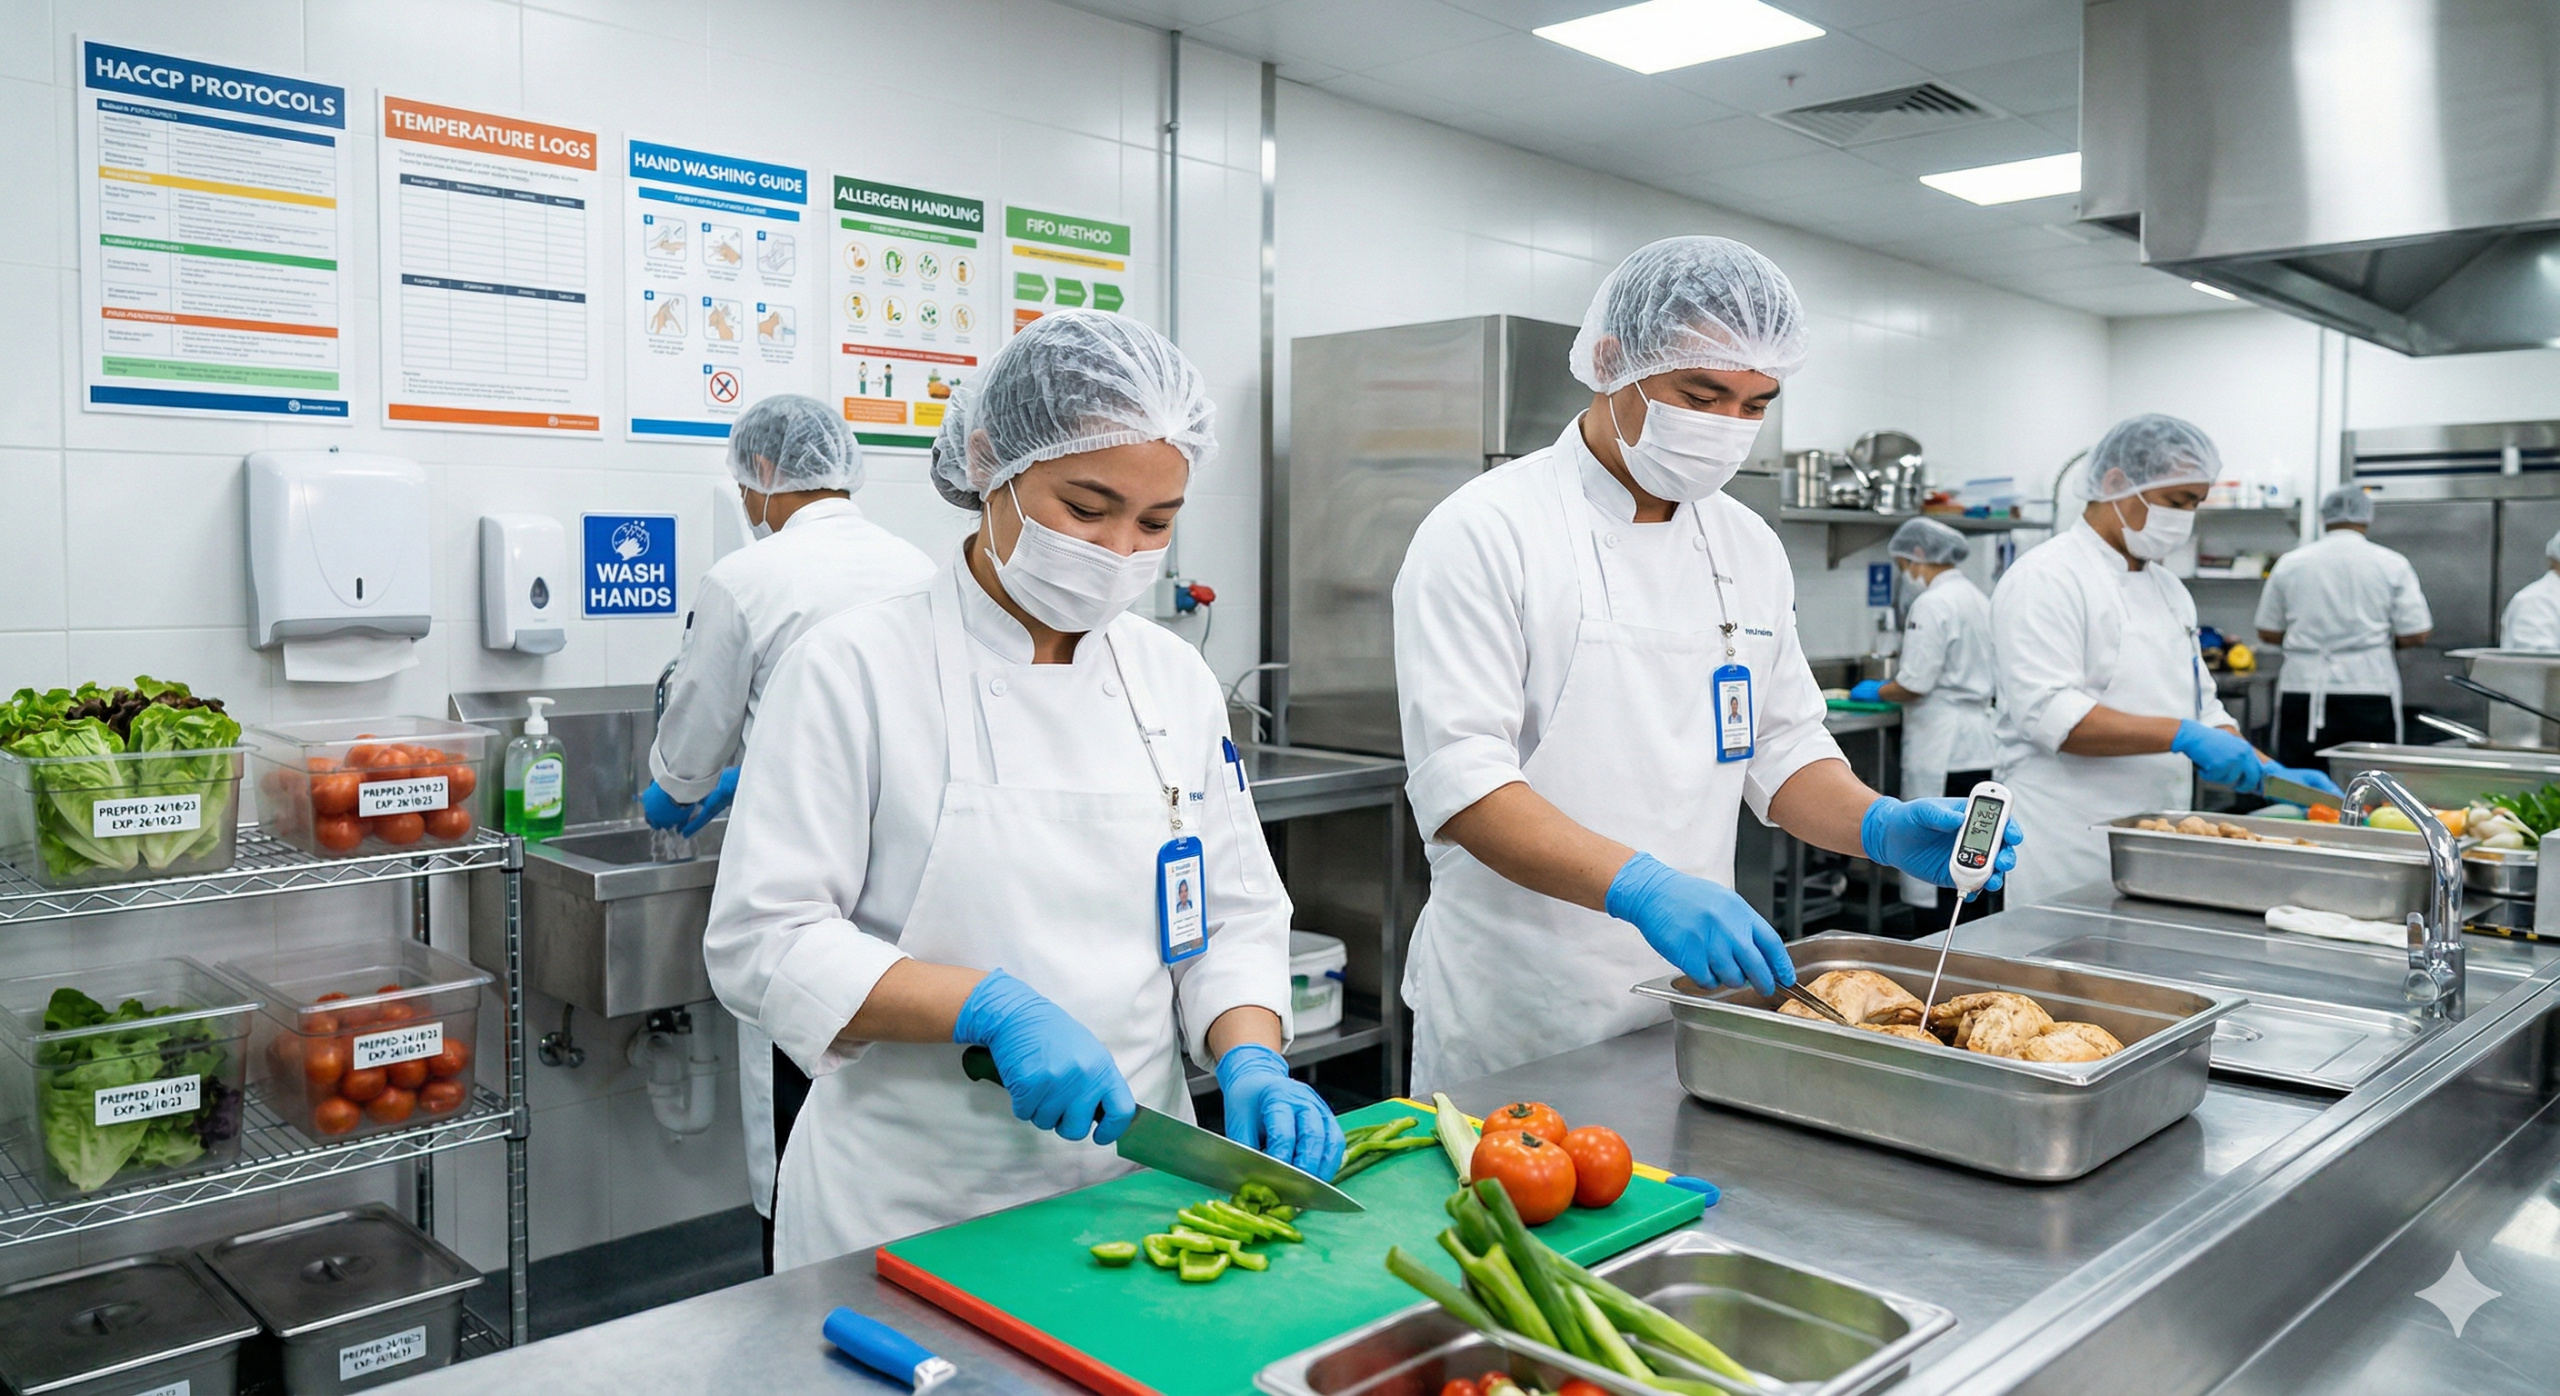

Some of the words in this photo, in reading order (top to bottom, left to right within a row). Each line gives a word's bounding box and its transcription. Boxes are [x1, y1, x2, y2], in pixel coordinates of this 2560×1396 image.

[95, 56, 185, 90] HACCP
[191, 74, 337, 117] PROTOCOLS
[391, 109, 535, 151] TEMPERATURE
[539, 134, 591, 160] LOGS
[634, 151, 681, 174] HAND
[682, 159, 757, 187] WASHING
[758, 173, 803, 194] GUIDE
[837, 185, 909, 212] ALLERGEN
[911, 198, 981, 223] HANDLING
[1026, 218, 1056, 236] FIFO
[1058, 223, 1112, 245] METHOD
[596, 563, 665, 583] WASH
[590, 587, 672, 607] HANDS
